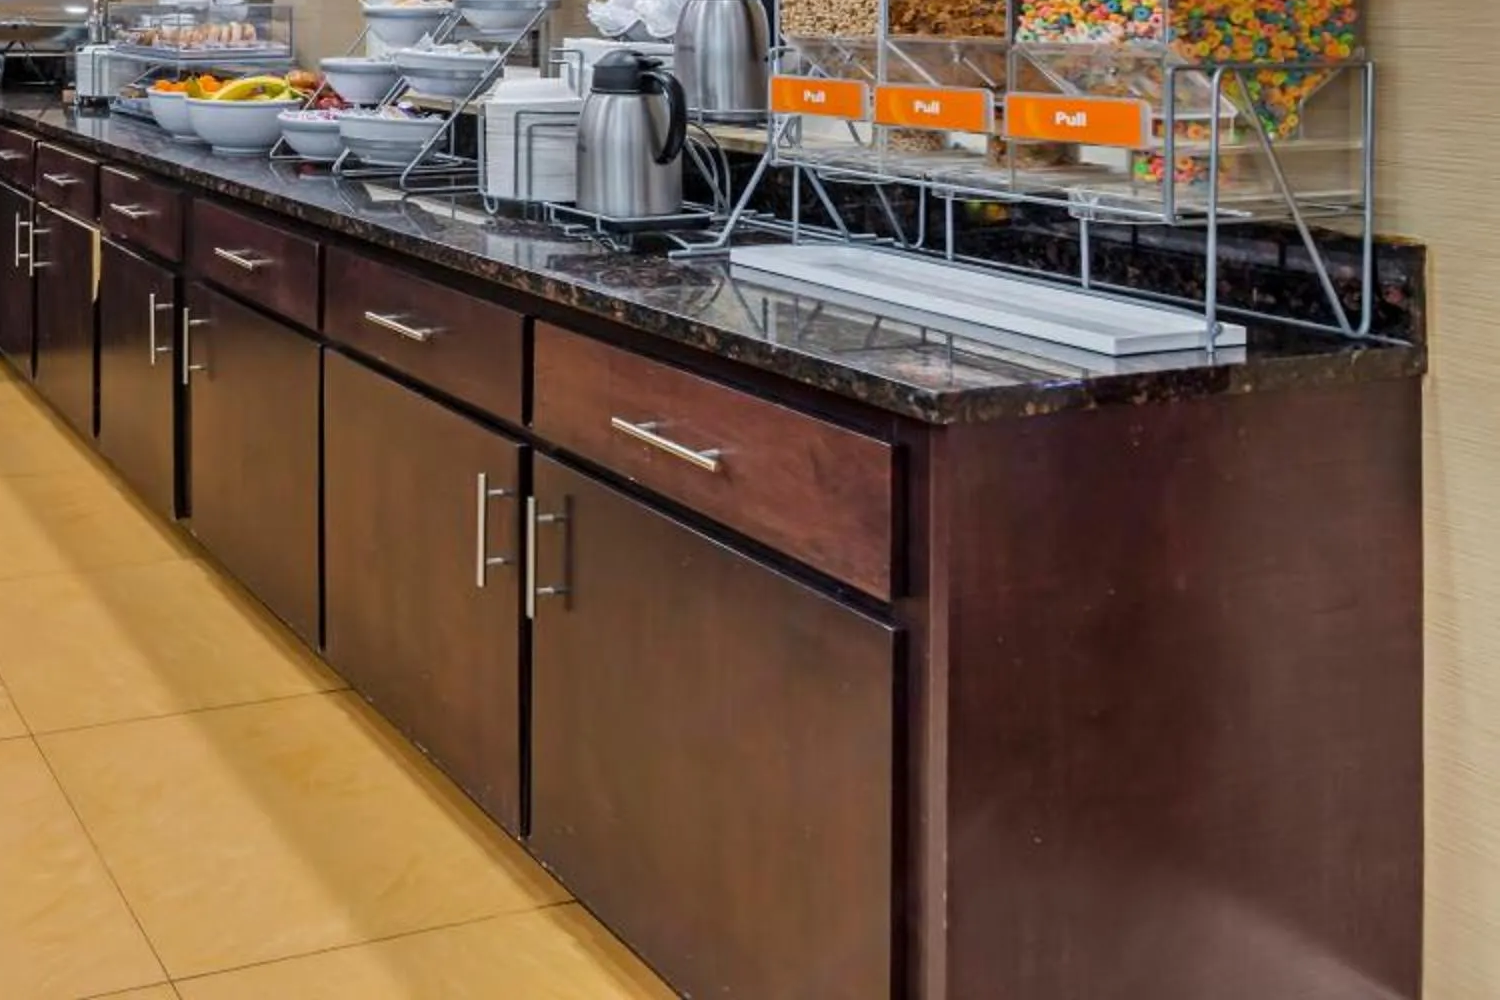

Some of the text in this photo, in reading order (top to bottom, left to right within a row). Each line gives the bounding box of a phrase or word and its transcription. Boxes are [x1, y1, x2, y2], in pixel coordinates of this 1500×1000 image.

[803, 88, 826, 103] Pull
[913, 99, 940, 115] Pull
[1054, 111, 1087, 127] Pull
